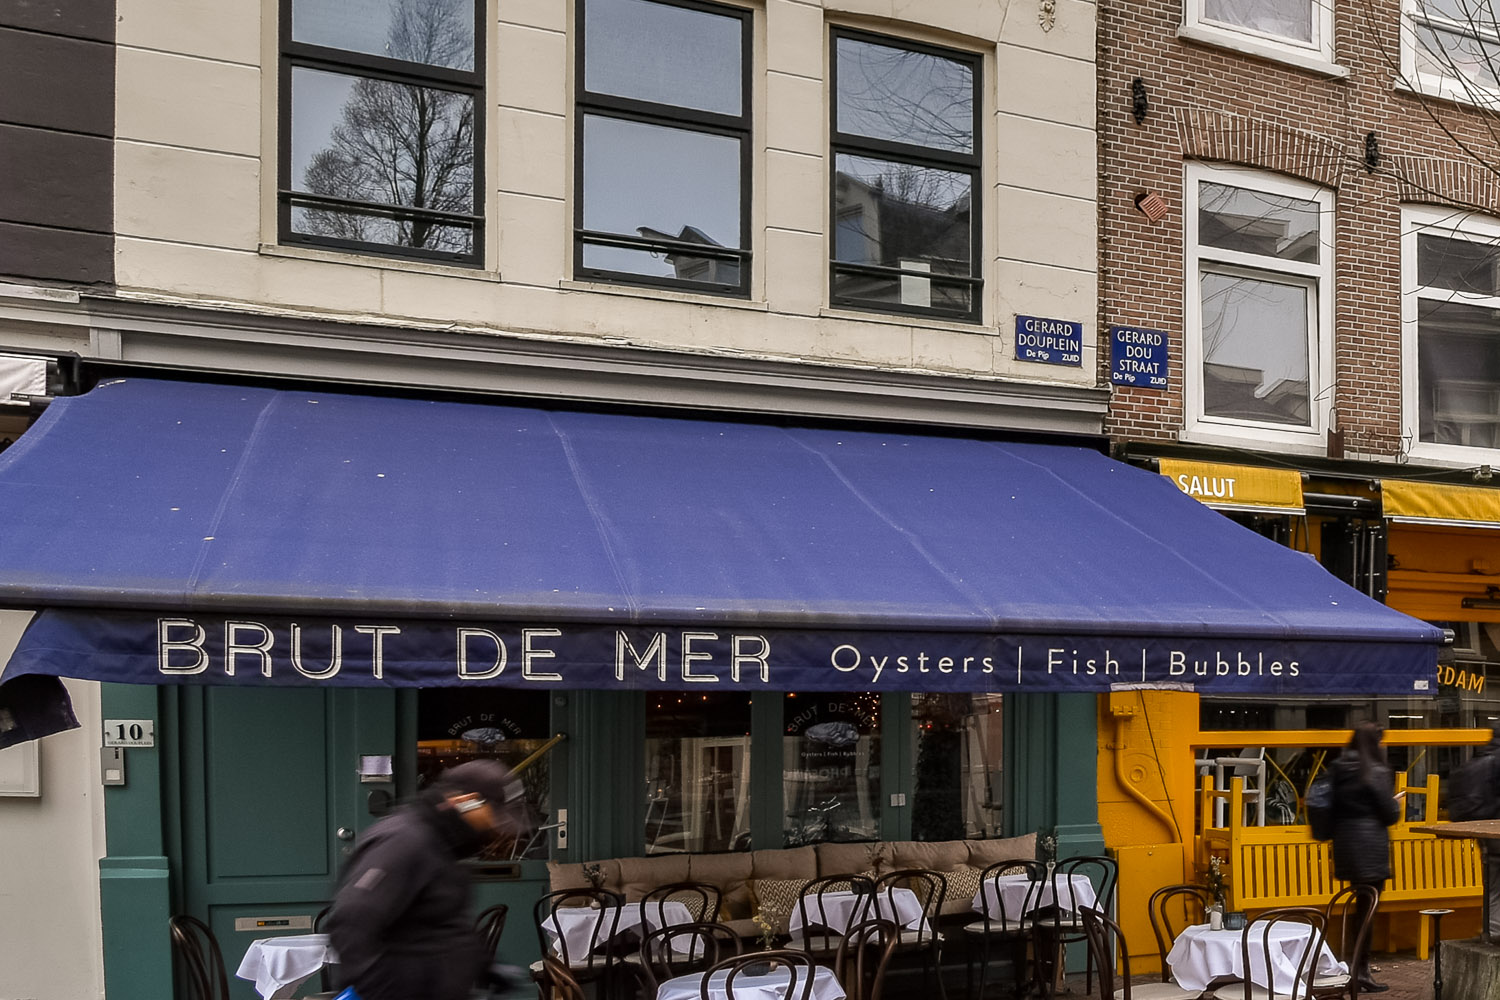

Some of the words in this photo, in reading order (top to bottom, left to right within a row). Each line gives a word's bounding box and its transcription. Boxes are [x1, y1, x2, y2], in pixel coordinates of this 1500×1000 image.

[1025, 319, 1073, 336] GERARD
[1018, 333, 1079, 352] DOUPLEIN
[1117, 330, 1162, 346] GERARD
[1026, 349, 1036, 358] De
[1038, 350, 1049, 360] Pijp
[1062, 353, 1080, 362] ZUID
[1126, 346, 1152, 359] DOU
[1119, 360, 1160, 374] STRAAT
[1113, 372, 1123, 380] De
[1124, 373, 1136, 383] Pijp
[1150, 376, 1167, 385] ZUID
[1178, 474, 1236, 498] SALUT
[157, 617, 401, 681] BRUT
[456, 627, 563, 681] DE
[615, 629, 771, 683] MER
[830, 644, 994, 683] Oysters
[1047, 648, 1120, 675] Fish
[1169, 650, 1300, 676] Bubbles
[1436, 664, 1485, 694] RDAM
[447, 715, 473, 736] BRUT
[480, 713, 496, 722] DE
[502, 717, 522, 735] MER
[787, 704, 818, 733] BRUT
[828, 702, 846, 713] DE
[115, 723, 143, 740] 10
